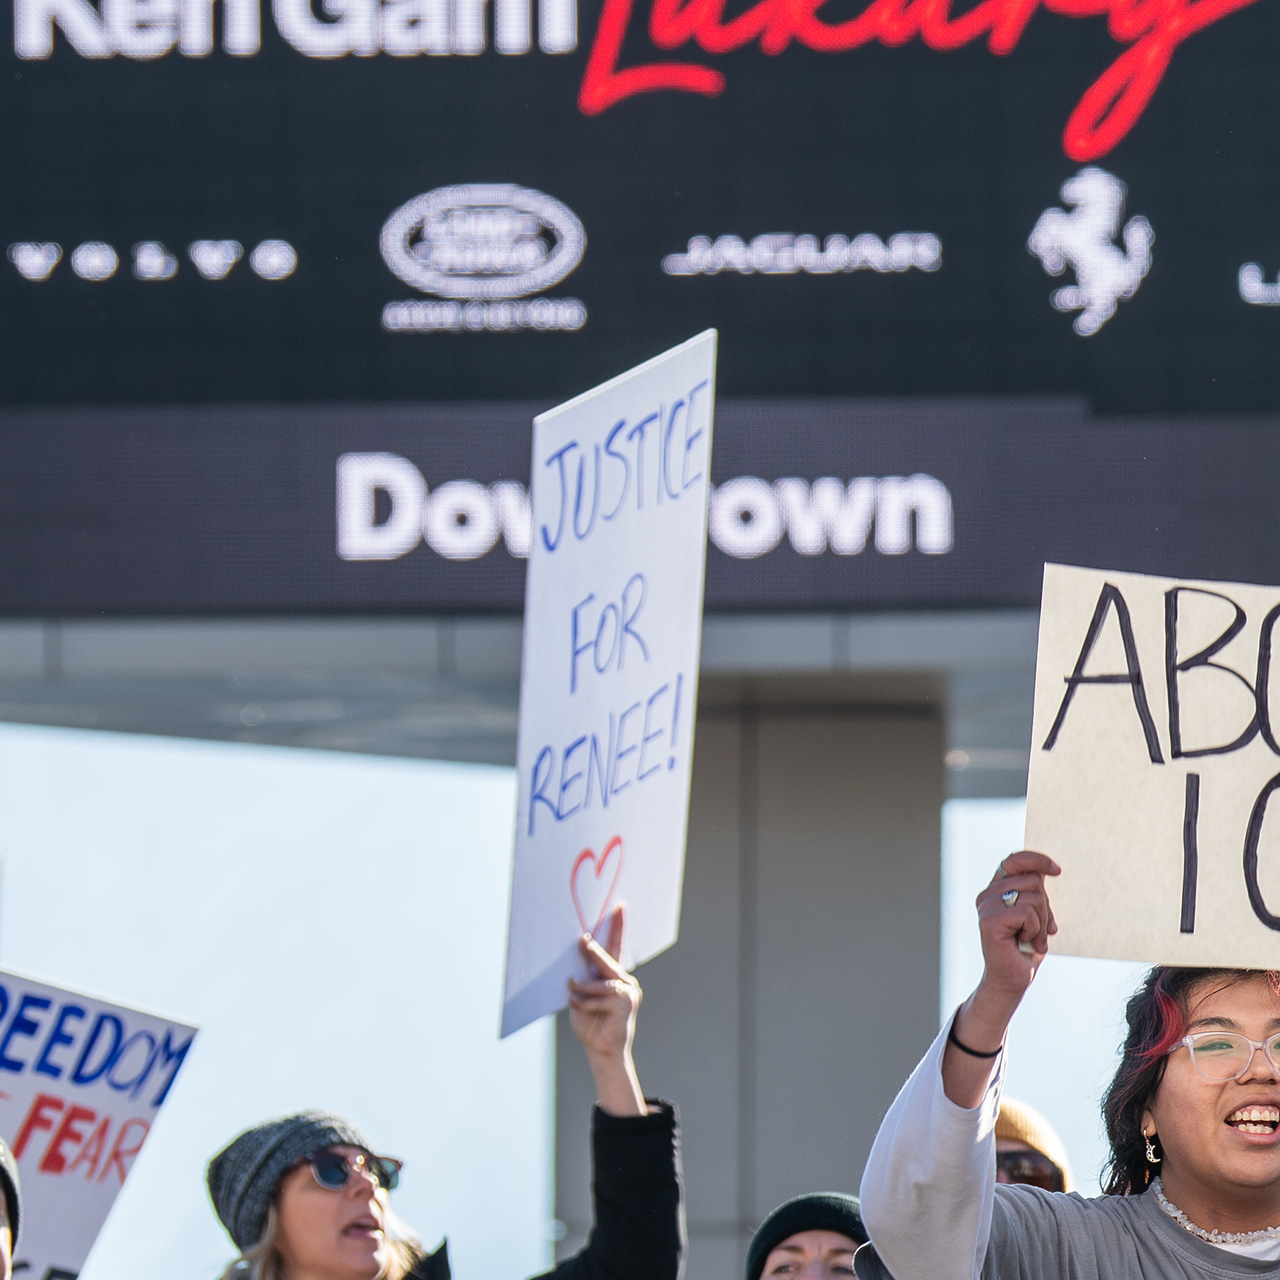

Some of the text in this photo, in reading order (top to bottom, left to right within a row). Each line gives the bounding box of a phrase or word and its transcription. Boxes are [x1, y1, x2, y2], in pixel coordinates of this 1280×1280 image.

[9, 240, 298, 281] VOLVO
[662, 233, 942, 276] JAGUAR
[541, 378, 709, 554] JUSTICE
[570, 573, 651, 695] FOR
[527, 673, 684, 837] RENEE!
[12, 1092, 152, 1187] FEAR
